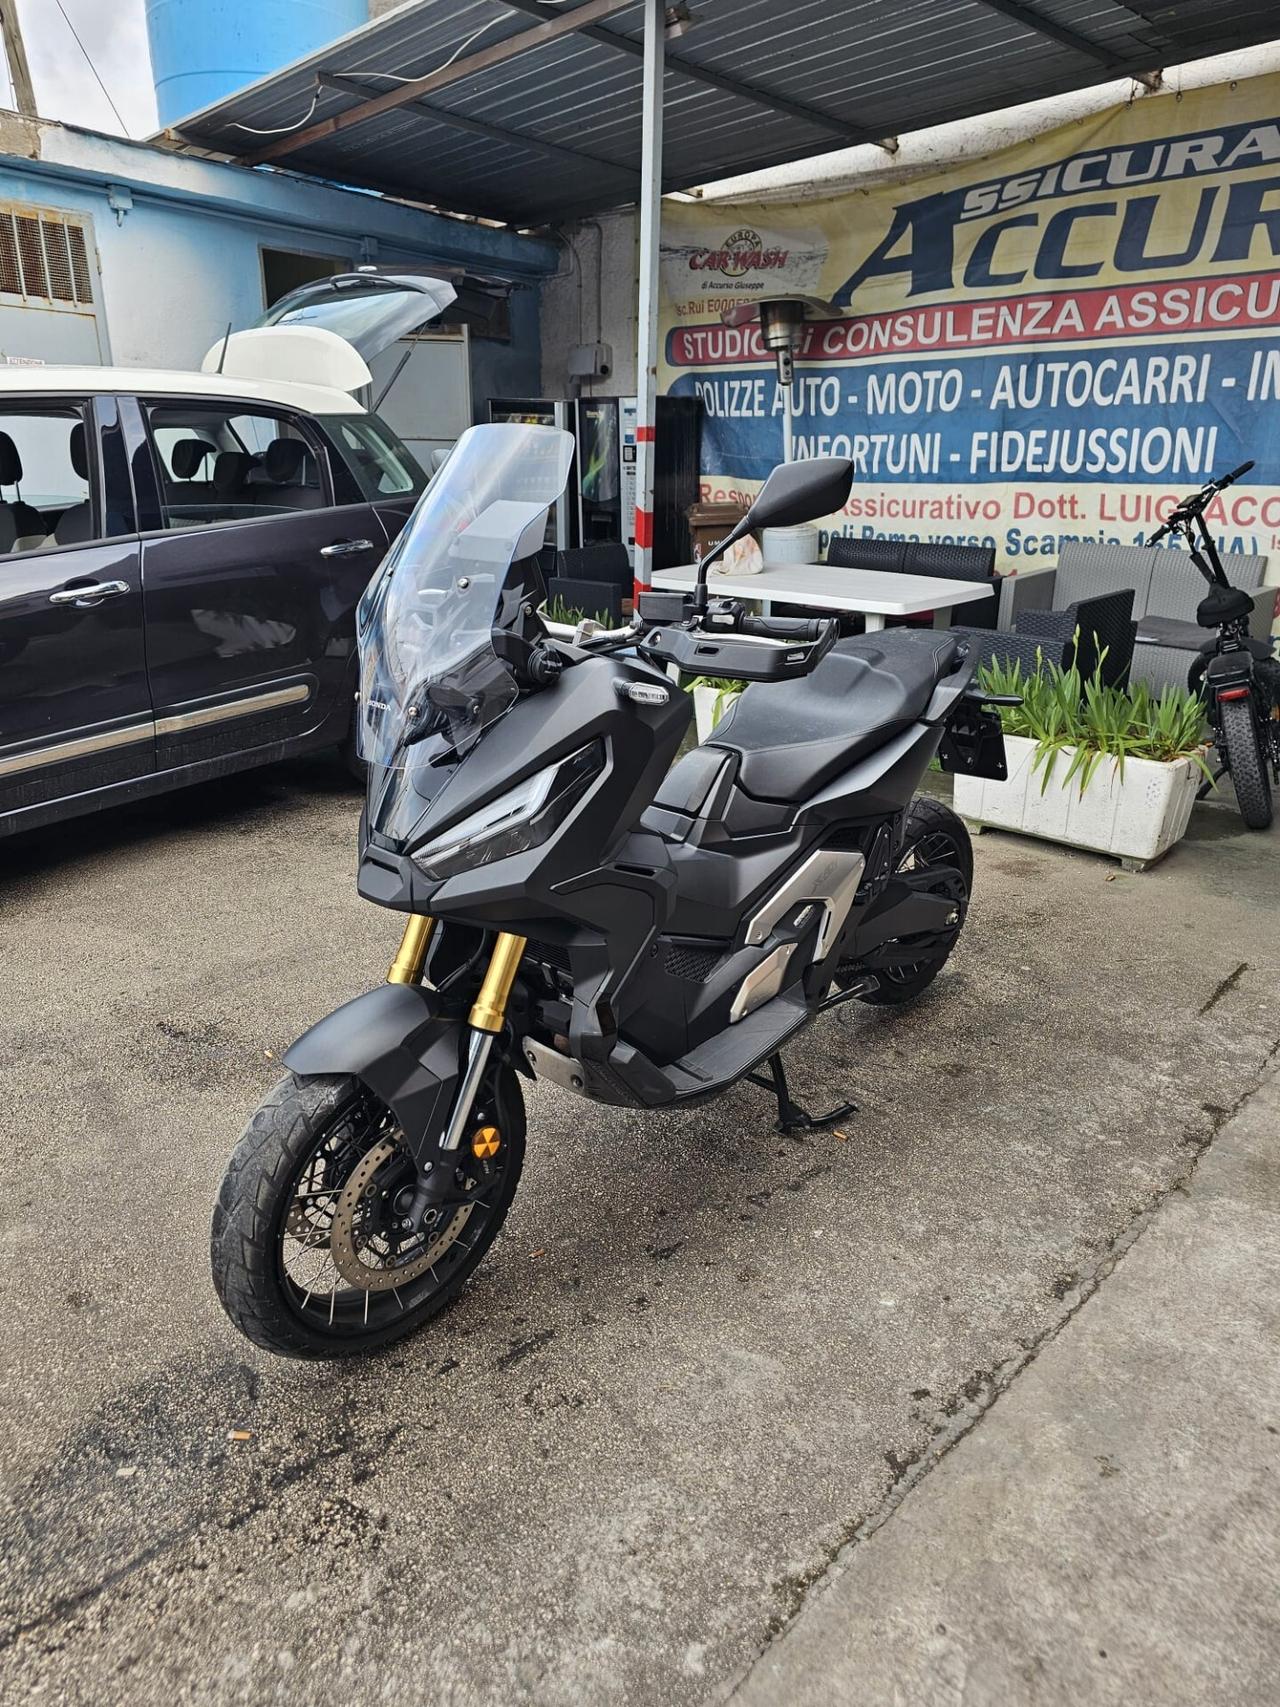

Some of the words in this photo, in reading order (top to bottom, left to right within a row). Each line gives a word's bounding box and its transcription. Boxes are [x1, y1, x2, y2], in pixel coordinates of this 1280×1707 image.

[725, 230, 761, 248] EUROPA
[689, 250, 729, 270] CAR
[731, 249, 790, 271] WASH
[702, 281, 708, 290] di
[709, 281, 734, 290] Accurso
[735, 281, 764, 290] Giuseppe
[822, 299, 1085, 354] CONSULENZA
[771, 376, 840, 417] AUTO
[867, 368, 963, 415] MOTO
[990, 353, 1211, 409] AUTOCARRI
[970, 426, 1218, 474] FIDEJUSSIONI
[1013, 491, 1086, 520] Dott.
